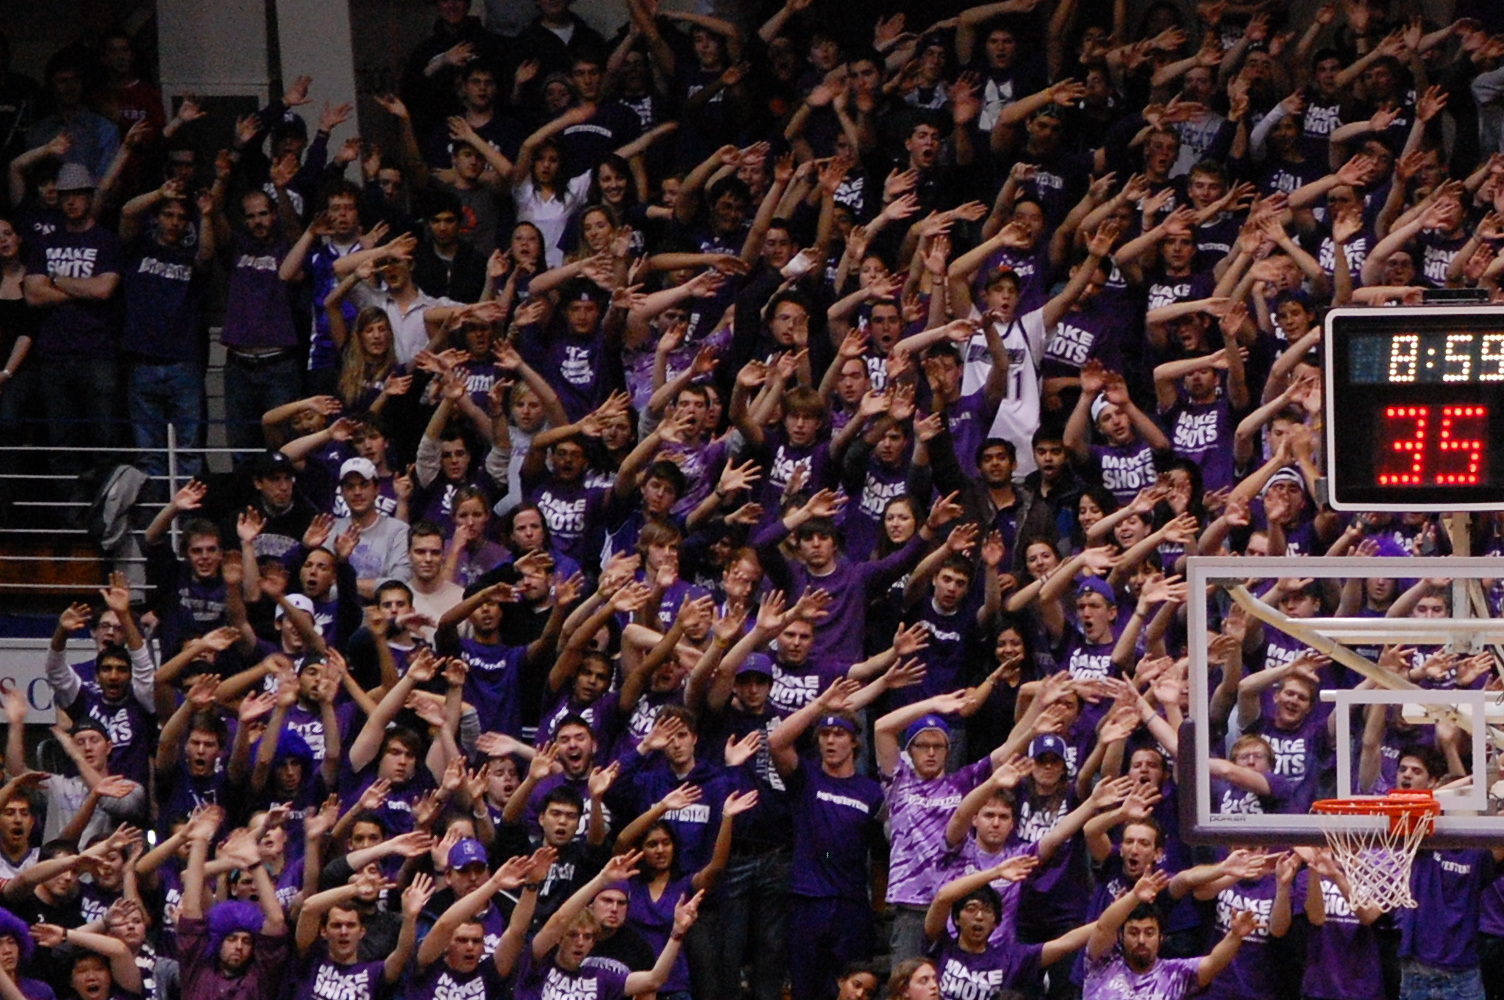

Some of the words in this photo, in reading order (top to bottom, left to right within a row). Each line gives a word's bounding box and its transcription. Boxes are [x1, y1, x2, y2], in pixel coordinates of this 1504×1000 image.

[46, 247, 97, 260] MAKE
[1378, 406, 1487, 486] 35
[1101, 447, 1154, 472] MAKE
[1102, 467, 1159, 493] SHOTS
[1273, 752, 1305, 778] OTS
[317, 964, 369, 986] MAKE
[547, 966, 599, 992] MAKE
[943, 959, 1004, 987] MAKE
